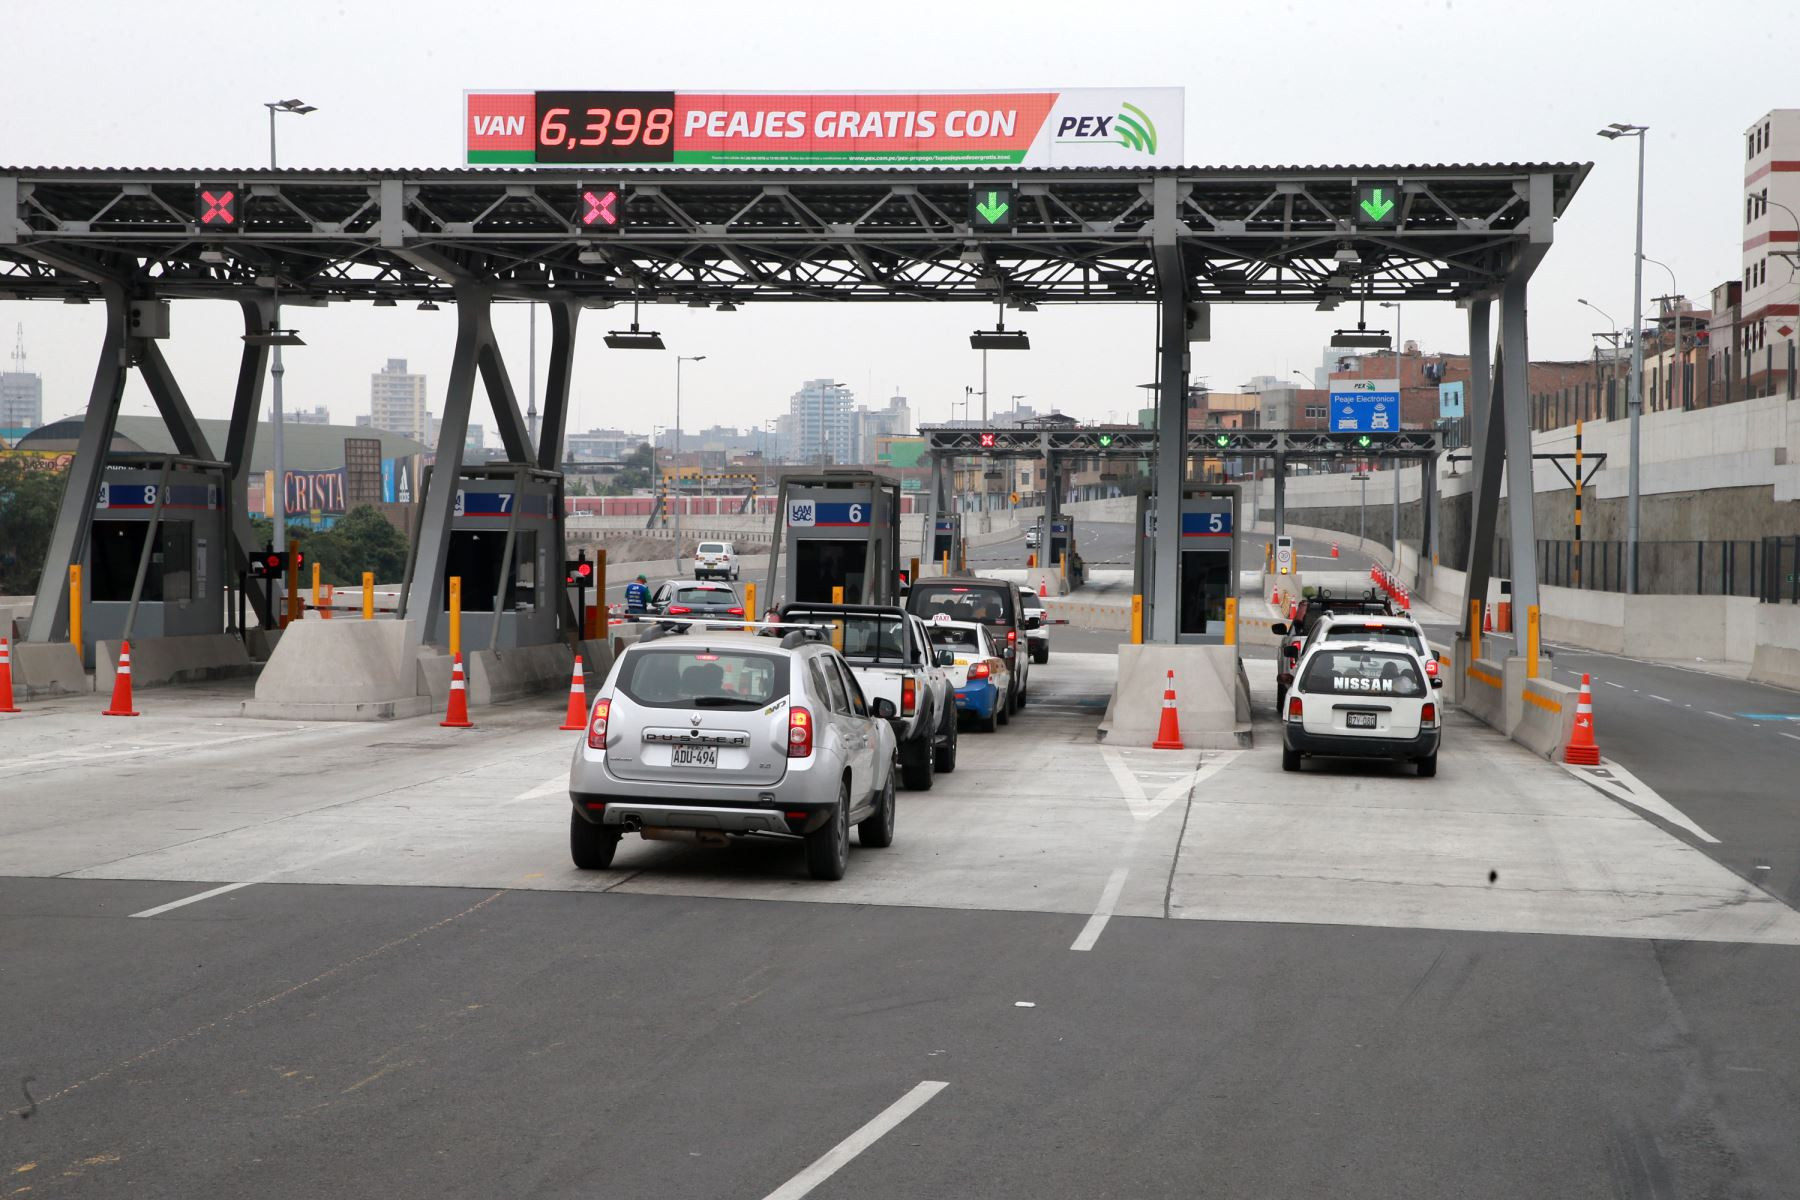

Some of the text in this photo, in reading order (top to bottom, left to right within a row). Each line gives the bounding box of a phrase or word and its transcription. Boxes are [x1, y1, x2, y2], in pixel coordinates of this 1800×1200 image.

[473, 115, 525, 136] VAN
[540, 107, 673, 150] 6,398
[684, 109, 1017, 138] PEAJES GRATIS CON
[1057, 116, 1113, 137] PEX
[1334, 395, 1354, 404] Peaje
[144, 485, 156, 505] 8
[498, 494, 511, 512] 7
[792, 505, 812, 514] LAM
[849, 503, 862, 523] 6
[1209, 513, 1223, 533] 5
[1334, 677, 1393, 691] NISSAN
[646, 734, 745, 744] DUSTER
[673, 750, 715, 764] ADU-494
